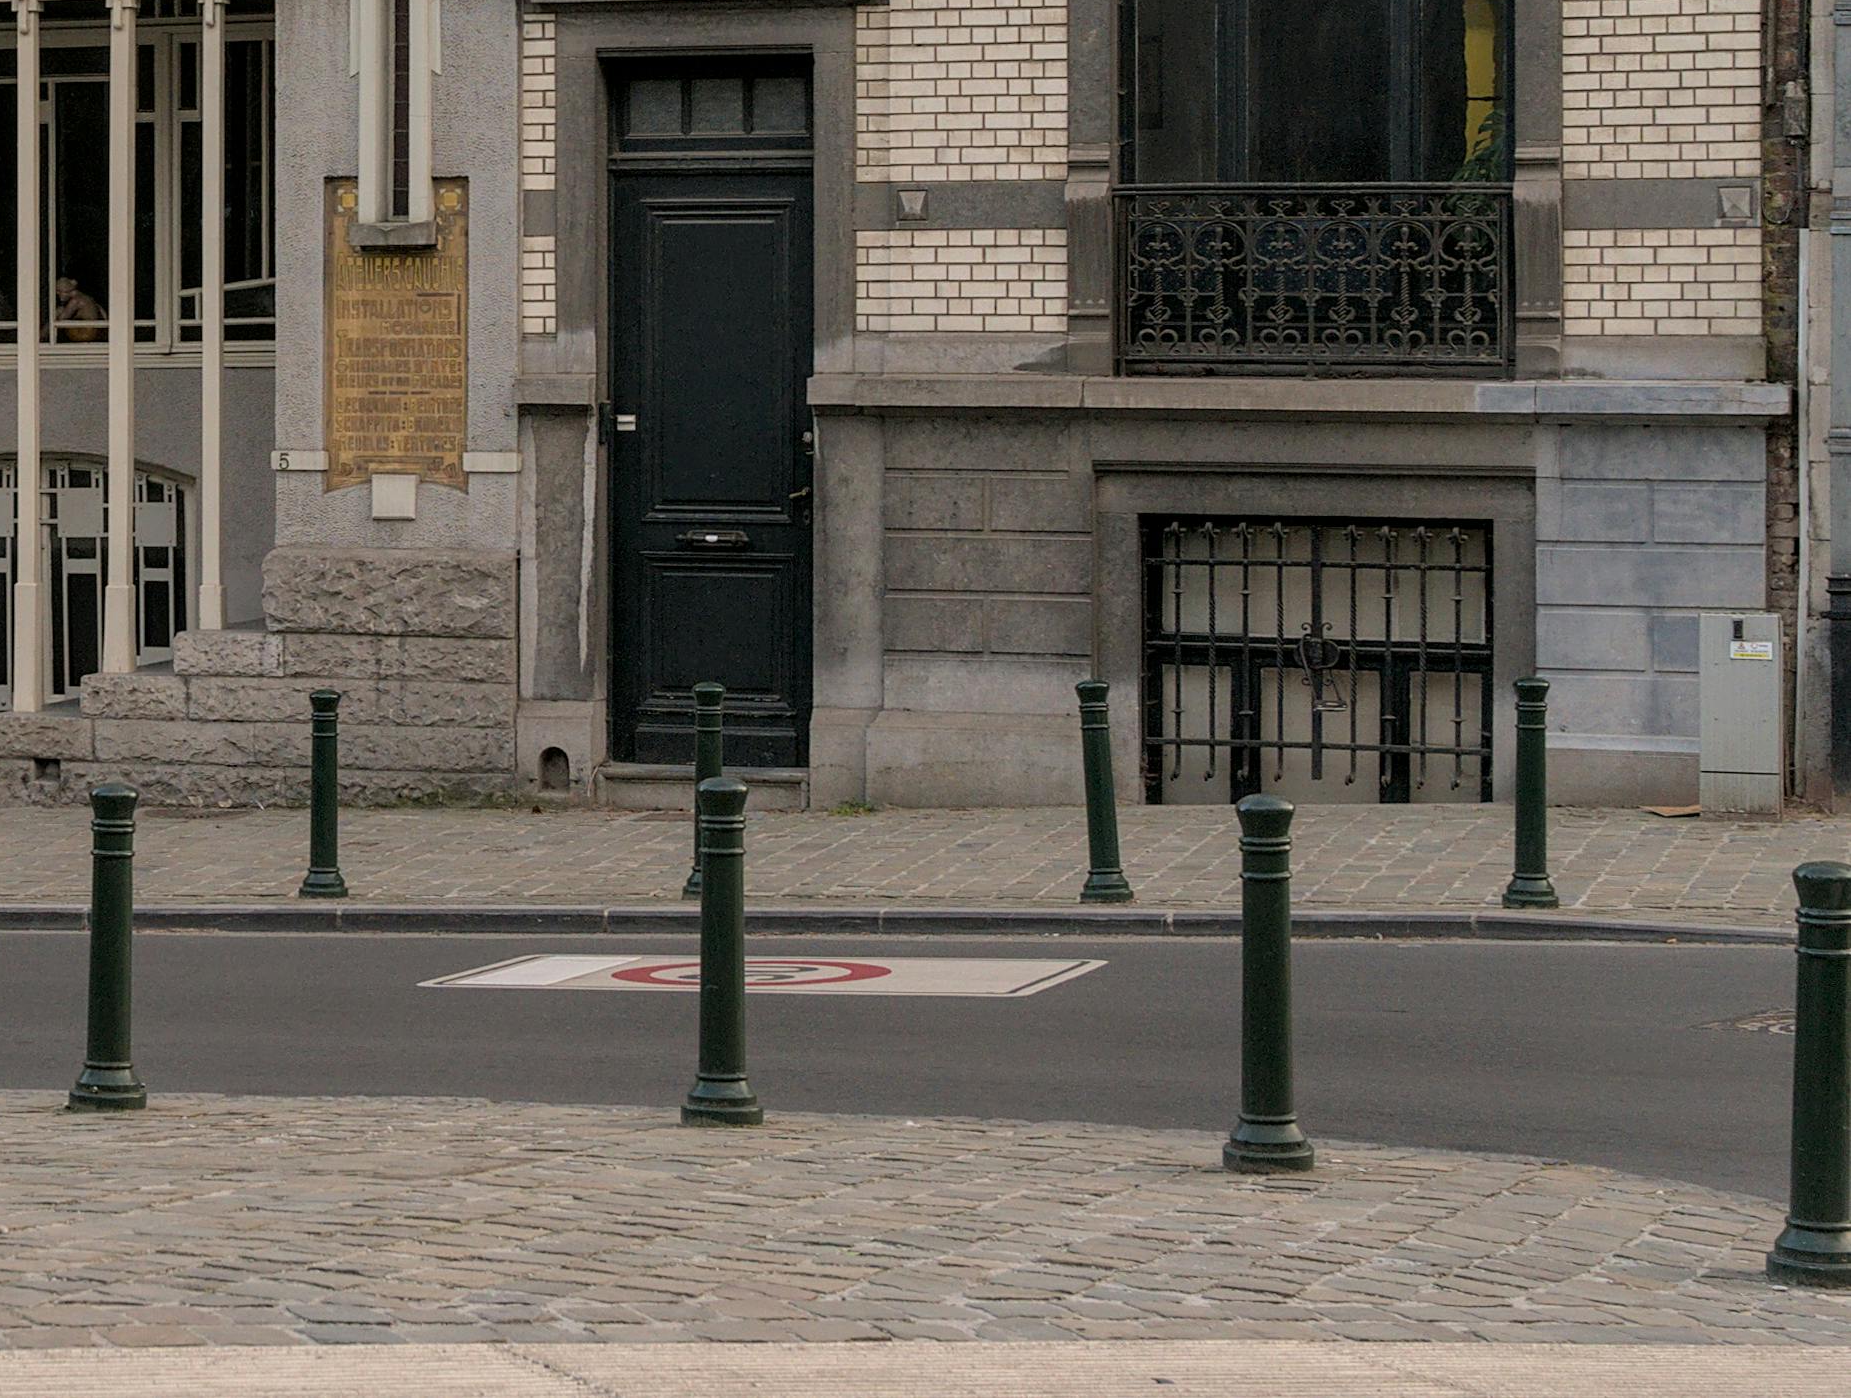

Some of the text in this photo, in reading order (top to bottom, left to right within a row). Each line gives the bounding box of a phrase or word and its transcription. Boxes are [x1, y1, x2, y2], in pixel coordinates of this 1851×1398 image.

[336, 252, 464, 291] ATELIERS CAUCHIE
[336, 296, 452, 320] INSTALLATIONS
[279, 452, 290, 470] 5
